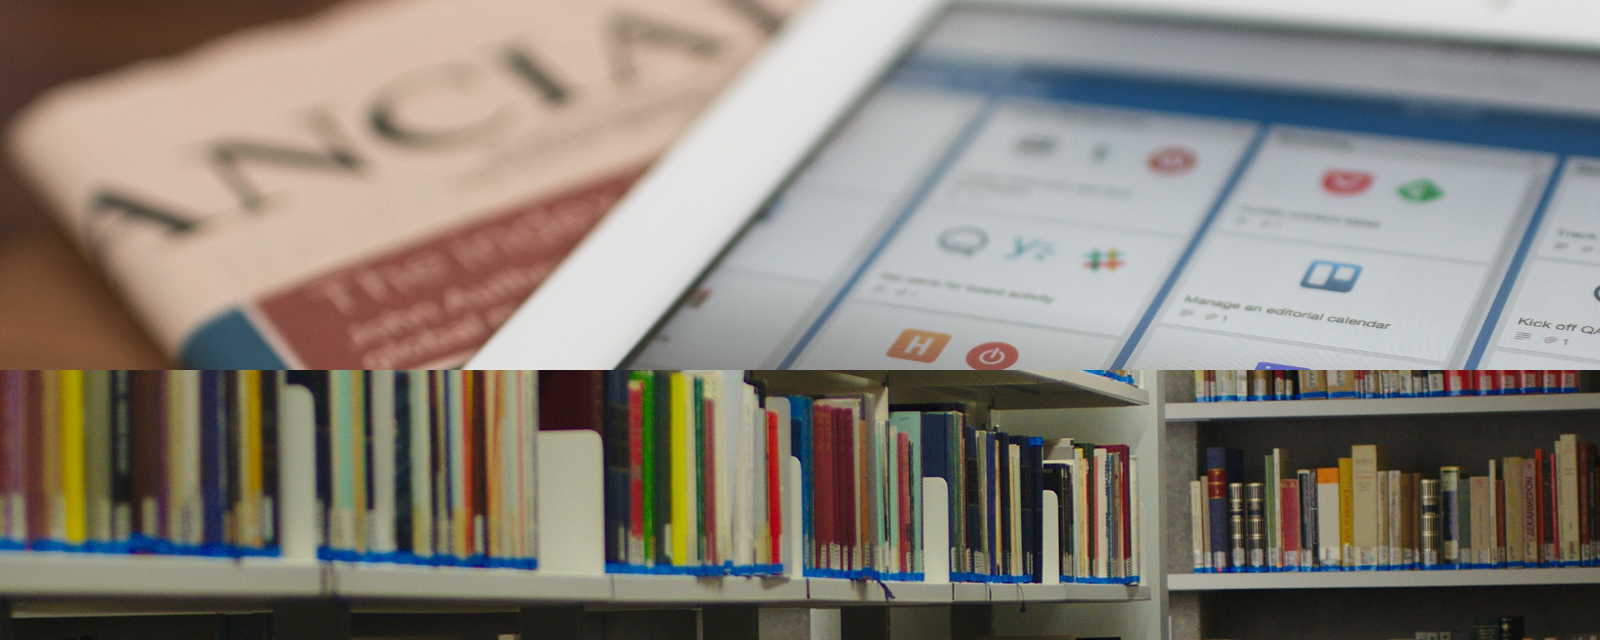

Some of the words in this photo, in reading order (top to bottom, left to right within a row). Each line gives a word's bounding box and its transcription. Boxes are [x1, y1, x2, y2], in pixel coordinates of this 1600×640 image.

[1183, 293, 1241, 311] Manage
[1244, 303, 1262, 313] an
[1266, 305, 1325, 322] editorial
[1327, 313, 1392, 330] calendar
[1222, 314, 1229, 322] 1
[1517, 316, 1552, 329] Kick
[1555, 322, 1579, 332] off
[904, 335, 933, 356] H
[1563, 338, 1569, 346] 1
